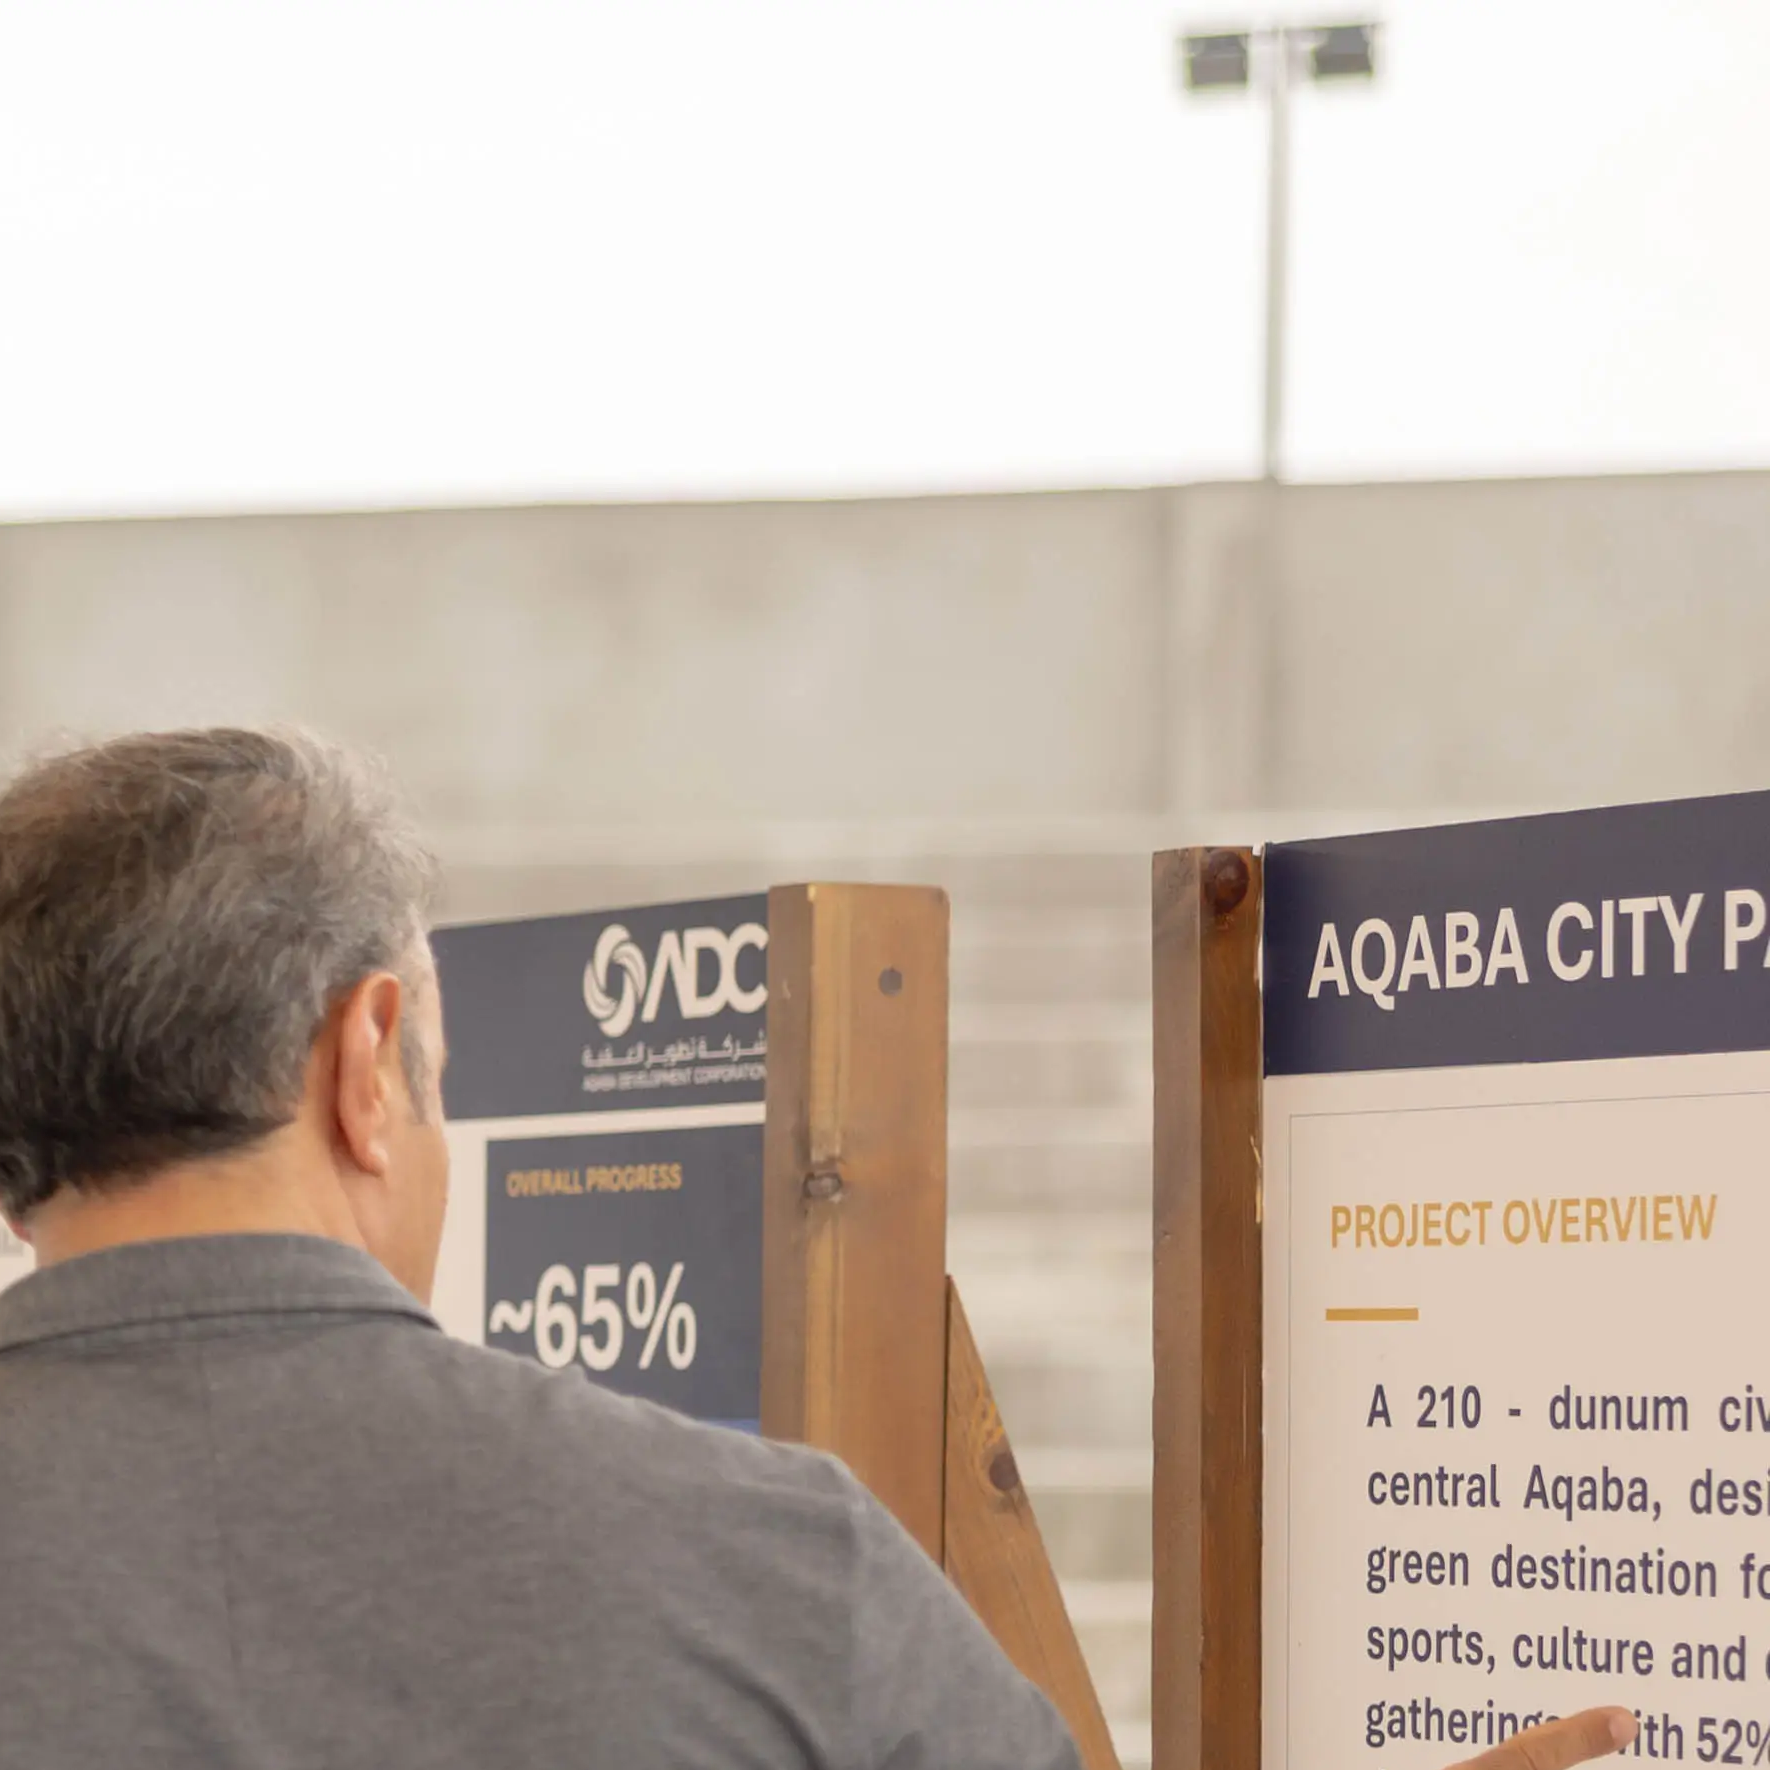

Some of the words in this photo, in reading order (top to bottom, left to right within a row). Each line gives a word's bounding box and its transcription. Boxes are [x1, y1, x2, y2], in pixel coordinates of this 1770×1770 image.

[641, 922, 769, 1022] ADC
[1307, 907, 1529, 1011] AQABA
[1546, 893, 1705, 982] CITY
[1724, 888, 1770, 970] P
[506, 1167, 582, 1197] OVERALL
[585, 1163, 683, 1193] PROGRESS
[1331, 1200, 1493, 1249] PROJECT
[1502, 1194, 1718, 1246] OVERVIEW
[1367, 1384, 1392, 1429] A
[1417, 1385, 1482, 1430] 210
[1549, 1385, 1689, 1433] dunum
[1367, 1464, 1500, 1509] central
[1524, 1464, 1662, 1522] Aqaba,
[1367, 1546, 1469, 1594] green
[1491, 1543, 1717, 1598] destination
[1367, 1623, 1496, 1675] sports,
[1512, 1627, 1654, 1676] culture
[1671, 1635, 1746, 1682] and
[1618, 1709, 1684, 1761] ith
